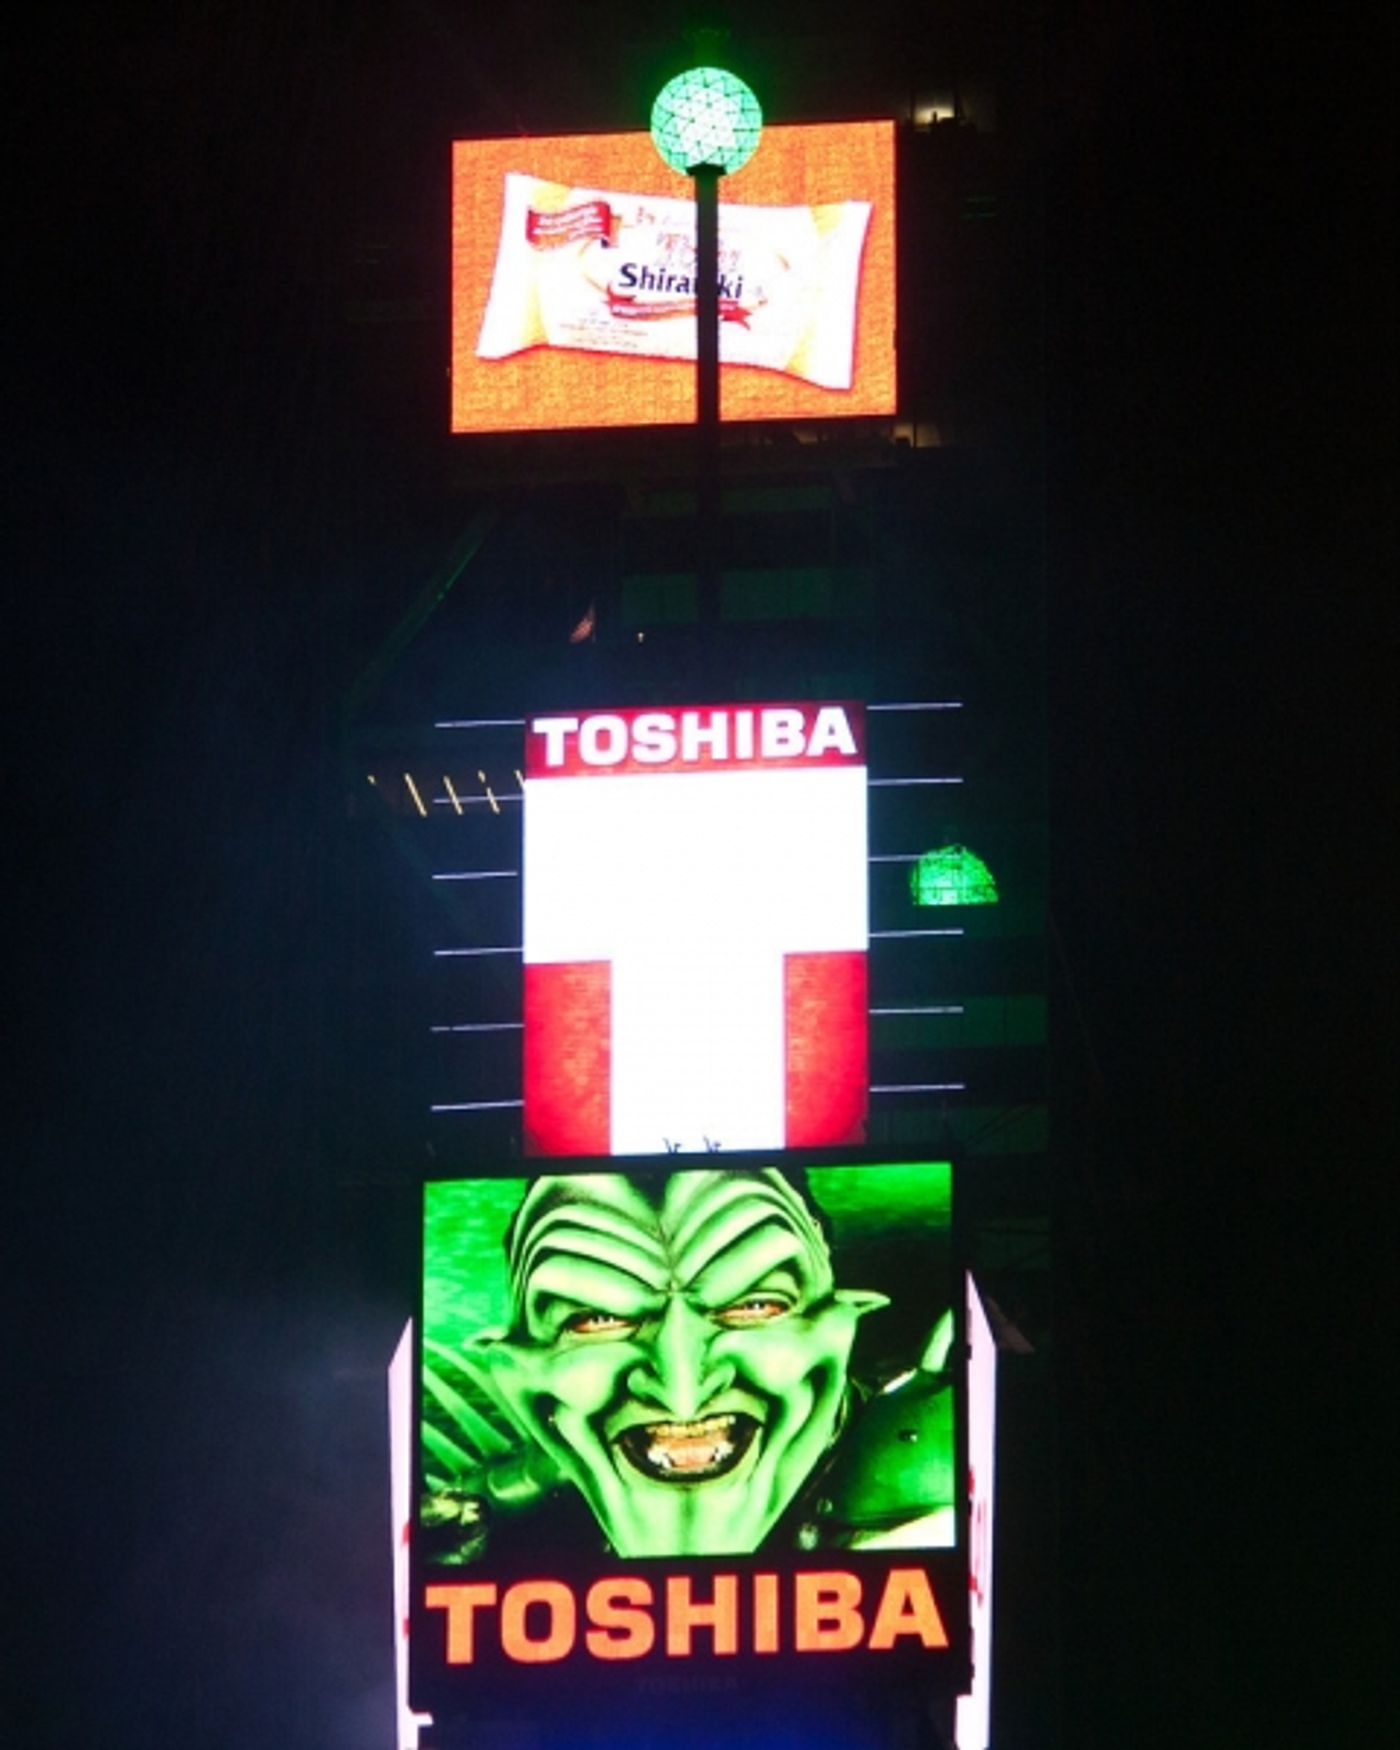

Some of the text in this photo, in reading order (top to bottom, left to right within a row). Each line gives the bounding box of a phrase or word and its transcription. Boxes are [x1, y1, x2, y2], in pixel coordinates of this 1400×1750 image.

[618, 263, 743, 298] Shiraki
[532, 706, 857, 767] TOSHIBA
[425, 1568, 948, 1664] TOSHIBA
